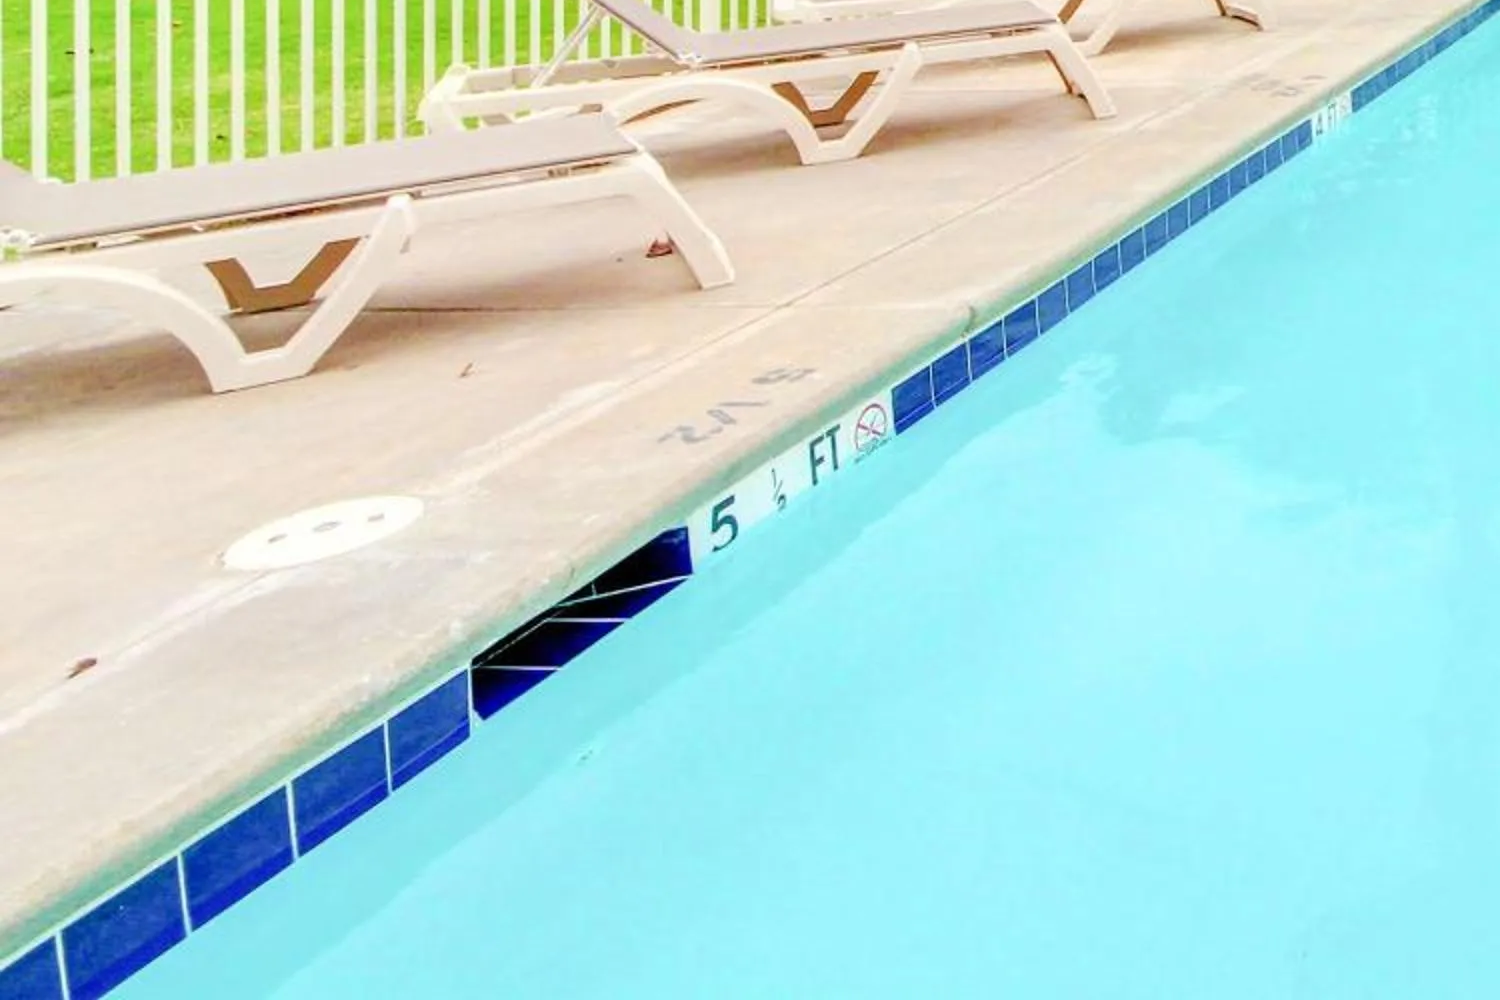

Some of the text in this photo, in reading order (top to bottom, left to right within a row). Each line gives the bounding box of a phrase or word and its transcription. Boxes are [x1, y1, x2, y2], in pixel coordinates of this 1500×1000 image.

[1327, 103, 1337, 131] FT
[711, 494, 739, 553] 5
[808, 424, 841, 486] FT
